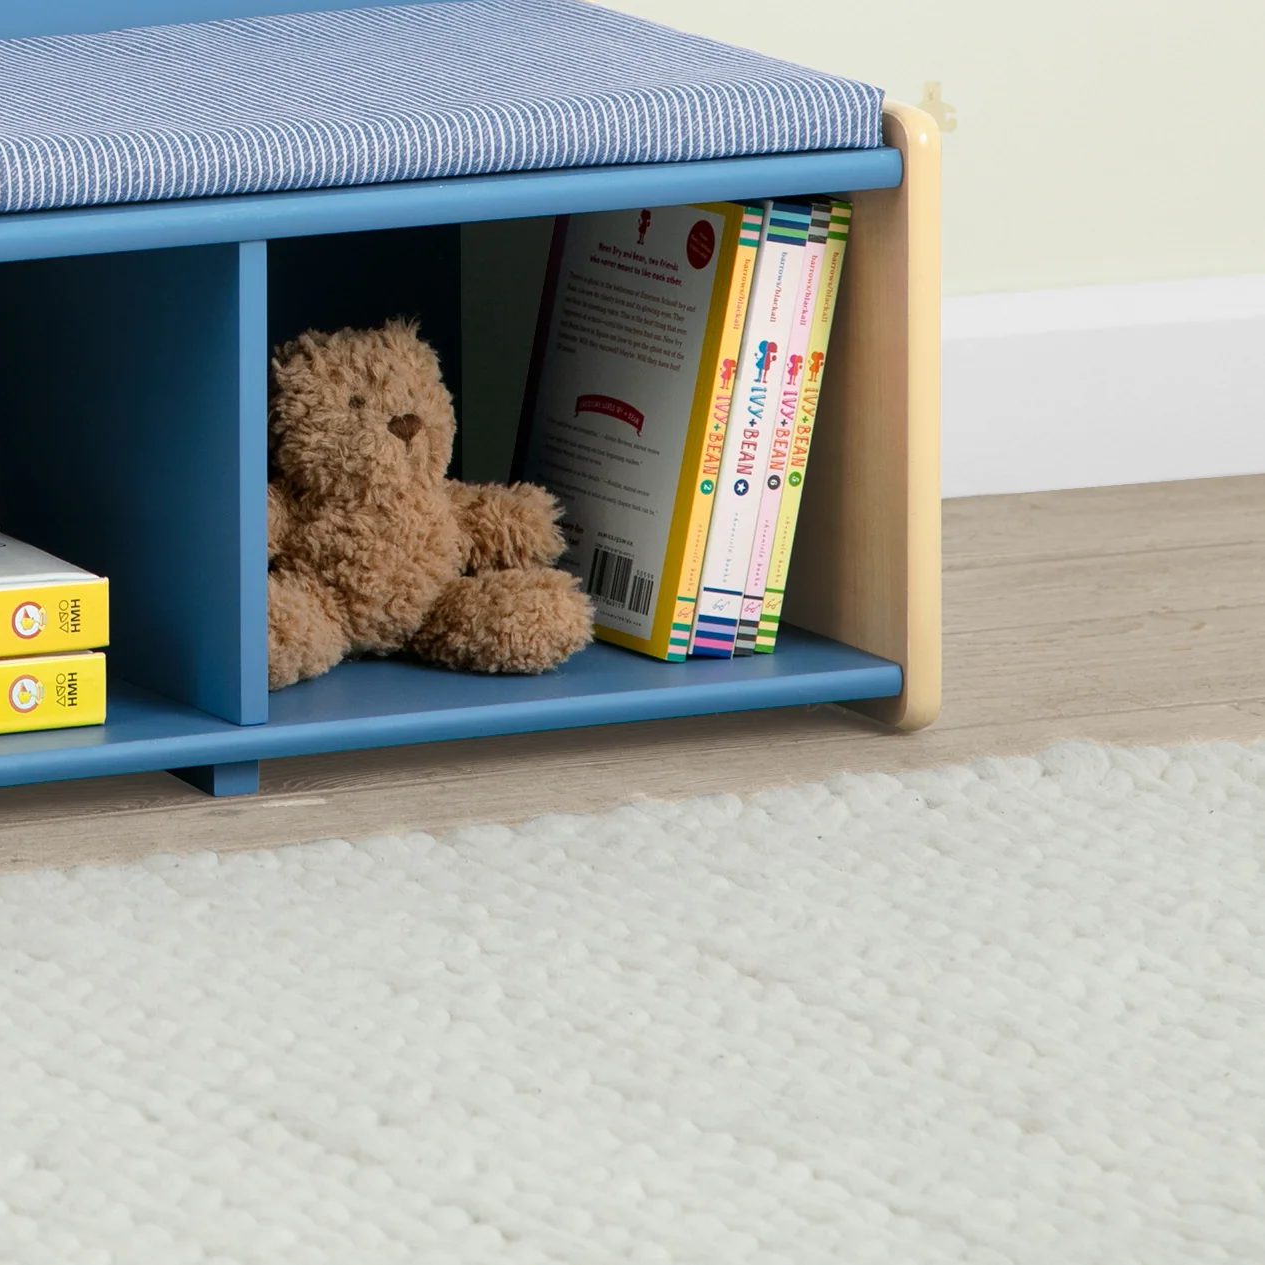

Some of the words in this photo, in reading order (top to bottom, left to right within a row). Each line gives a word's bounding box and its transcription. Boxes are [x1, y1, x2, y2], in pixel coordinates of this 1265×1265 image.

[634, 266, 640, 275] to
[641, 268, 651, 278] like
[652, 272, 665, 282] each
[649, 256, 658, 266] two
[659, 258, 679, 272] friends
[733, 258, 751, 330] barrows/blackall
[770, 251, 788, 323] barrows/blackall
[800, 255, 818, 326] barrows/blackall
[821, 251, 840, 323] barrows/blackall
[702, 432, 724, 475] BEAN
[736, 428, 760, 475] BEAN
[769, 428, 790, 471] BEAN
[791, 424, 811, 468] BEAN
[70, 598, 81, 633] HMH
[67, 672, 78, 707] HMH
